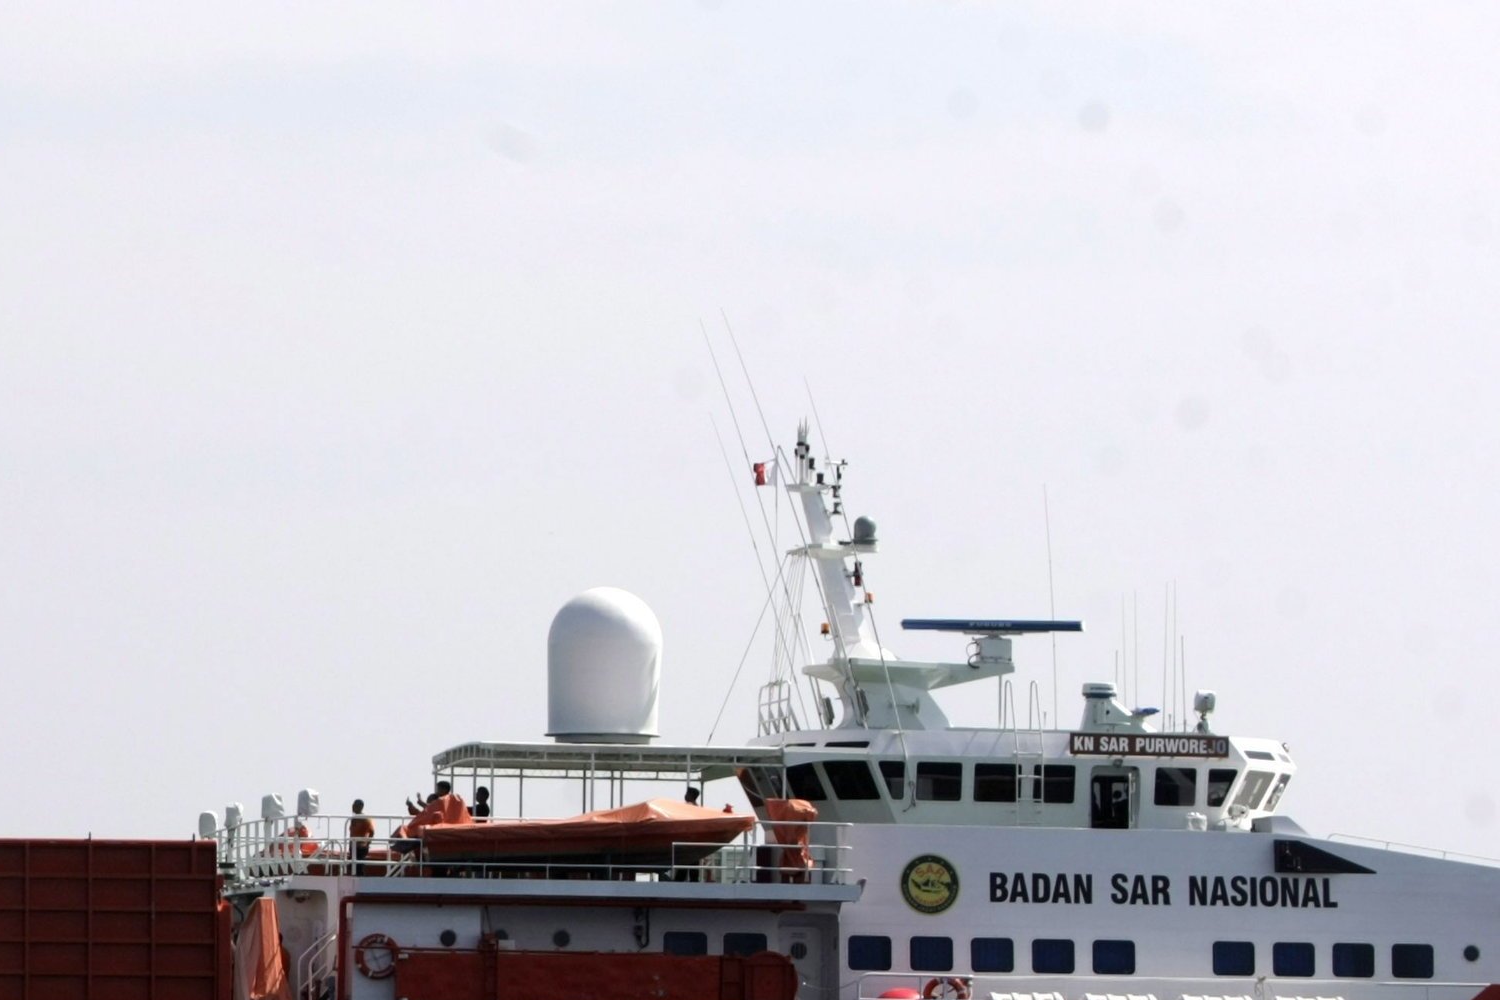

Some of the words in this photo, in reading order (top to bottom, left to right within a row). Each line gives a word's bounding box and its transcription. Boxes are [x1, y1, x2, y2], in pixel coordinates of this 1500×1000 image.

[1073, 735, 1095, 752] KN
[1099, 736, 1129, 753] SAR
[1135, 737, 1226, 755] PURWOREJO
[989, 872, 1093, 905] BADAN
[1110, 873, 1172, 906] SAR
[1188, 875, 1339, 909] NASIONAL
